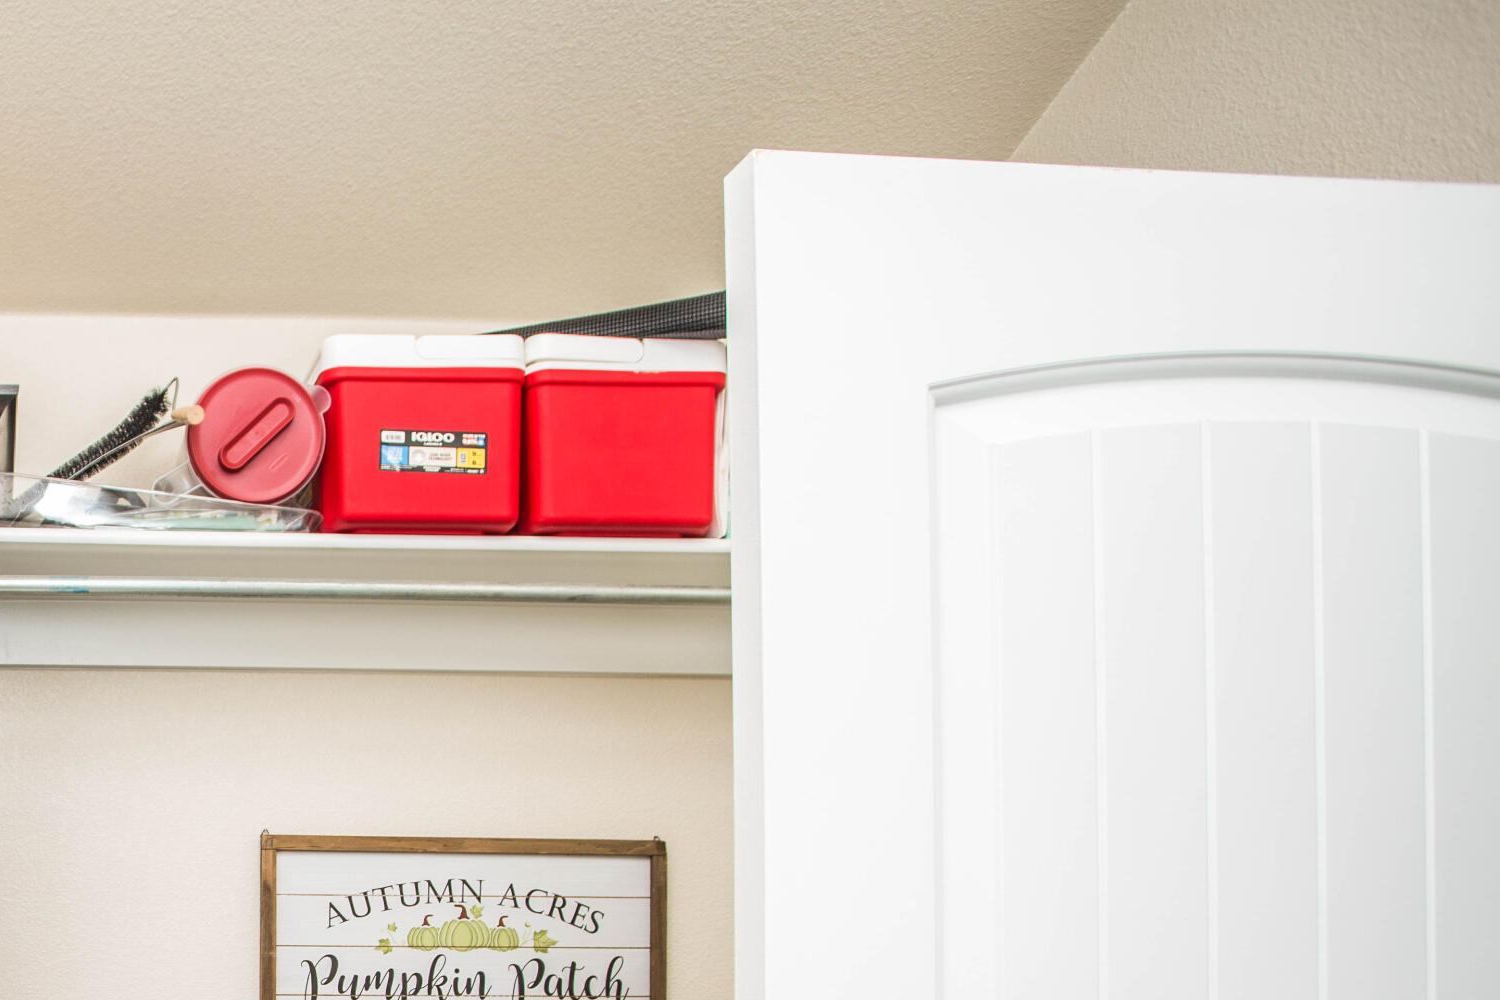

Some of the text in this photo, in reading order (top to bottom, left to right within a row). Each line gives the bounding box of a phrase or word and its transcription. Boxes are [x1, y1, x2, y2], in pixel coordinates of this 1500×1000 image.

[411, 431, 455, 443] IGLOO
[326, 878, 605, 934] AUTUMN ACRES
